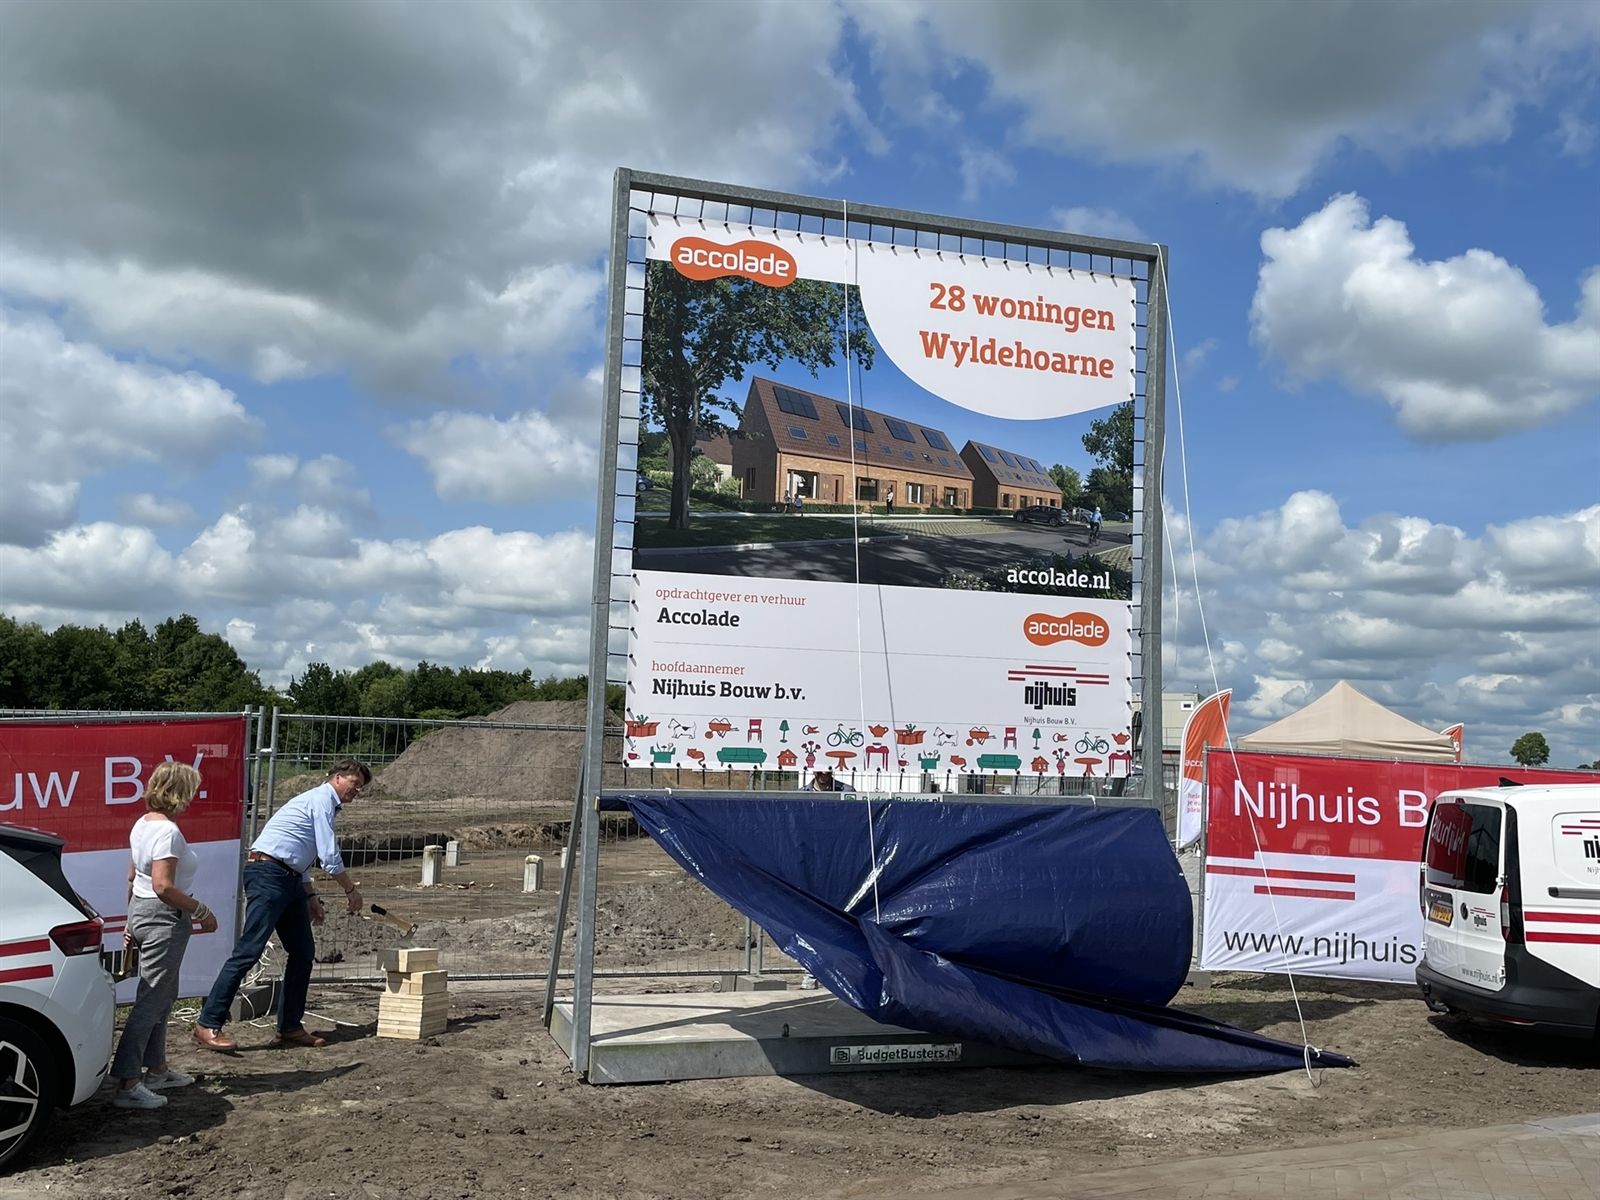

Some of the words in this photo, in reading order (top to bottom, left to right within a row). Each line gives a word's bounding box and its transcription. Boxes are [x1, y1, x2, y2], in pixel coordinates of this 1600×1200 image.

[677, 246, 790, 277] accolade
[929, 282, 966, 312] 28
[972, 295, 1116, 333] woningen
[919, 330, 1115, 379] Wyldehoarne
[1006, 567, 1111, 590] accolade.nl
[655, 588, 741, 603] opdrachtgever
[744, 594, 759, 603] en
[760, 592, 806, 606] verhuur
[656, 607, 741, 627] Accolade
[1028, 619, 1105, 639] accolade
[651, 660, 745, 675] hoofdaannemer
[652, 678, 716, 700] Nijhuis
[719, 681, 771, 699] Bouw
[774, 683, 806, 700] b.v.
[1024, 681, 1077, 710] nijhuis
[1024, 716, 1045, 725] Nijhuis
[1047, 717, 1063, 725] Bouw
[1234, 779, 1381, 829] Nijhuis
